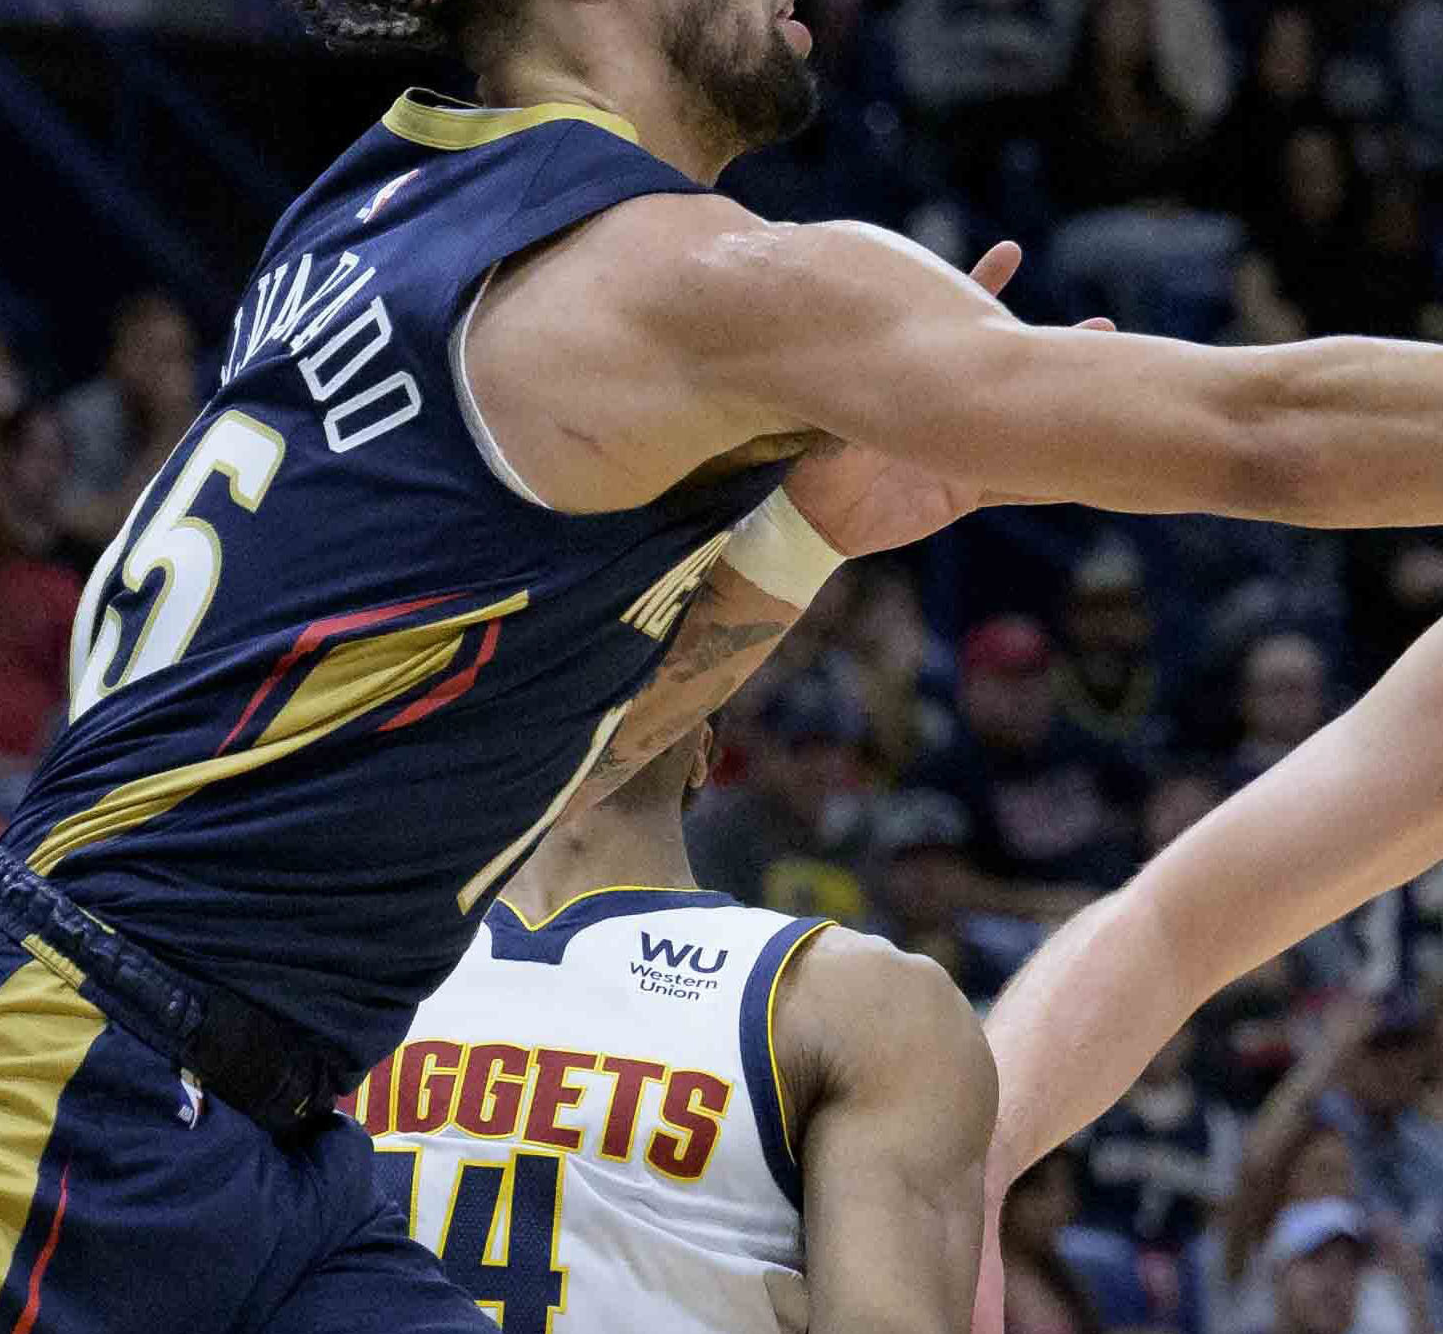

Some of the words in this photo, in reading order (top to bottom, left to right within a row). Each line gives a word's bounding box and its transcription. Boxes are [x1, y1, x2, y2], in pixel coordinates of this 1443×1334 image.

[640, 930, 729, 974] WU
[630, 961, 718, 990] Western
[640, 978, 701, 1001] Union
